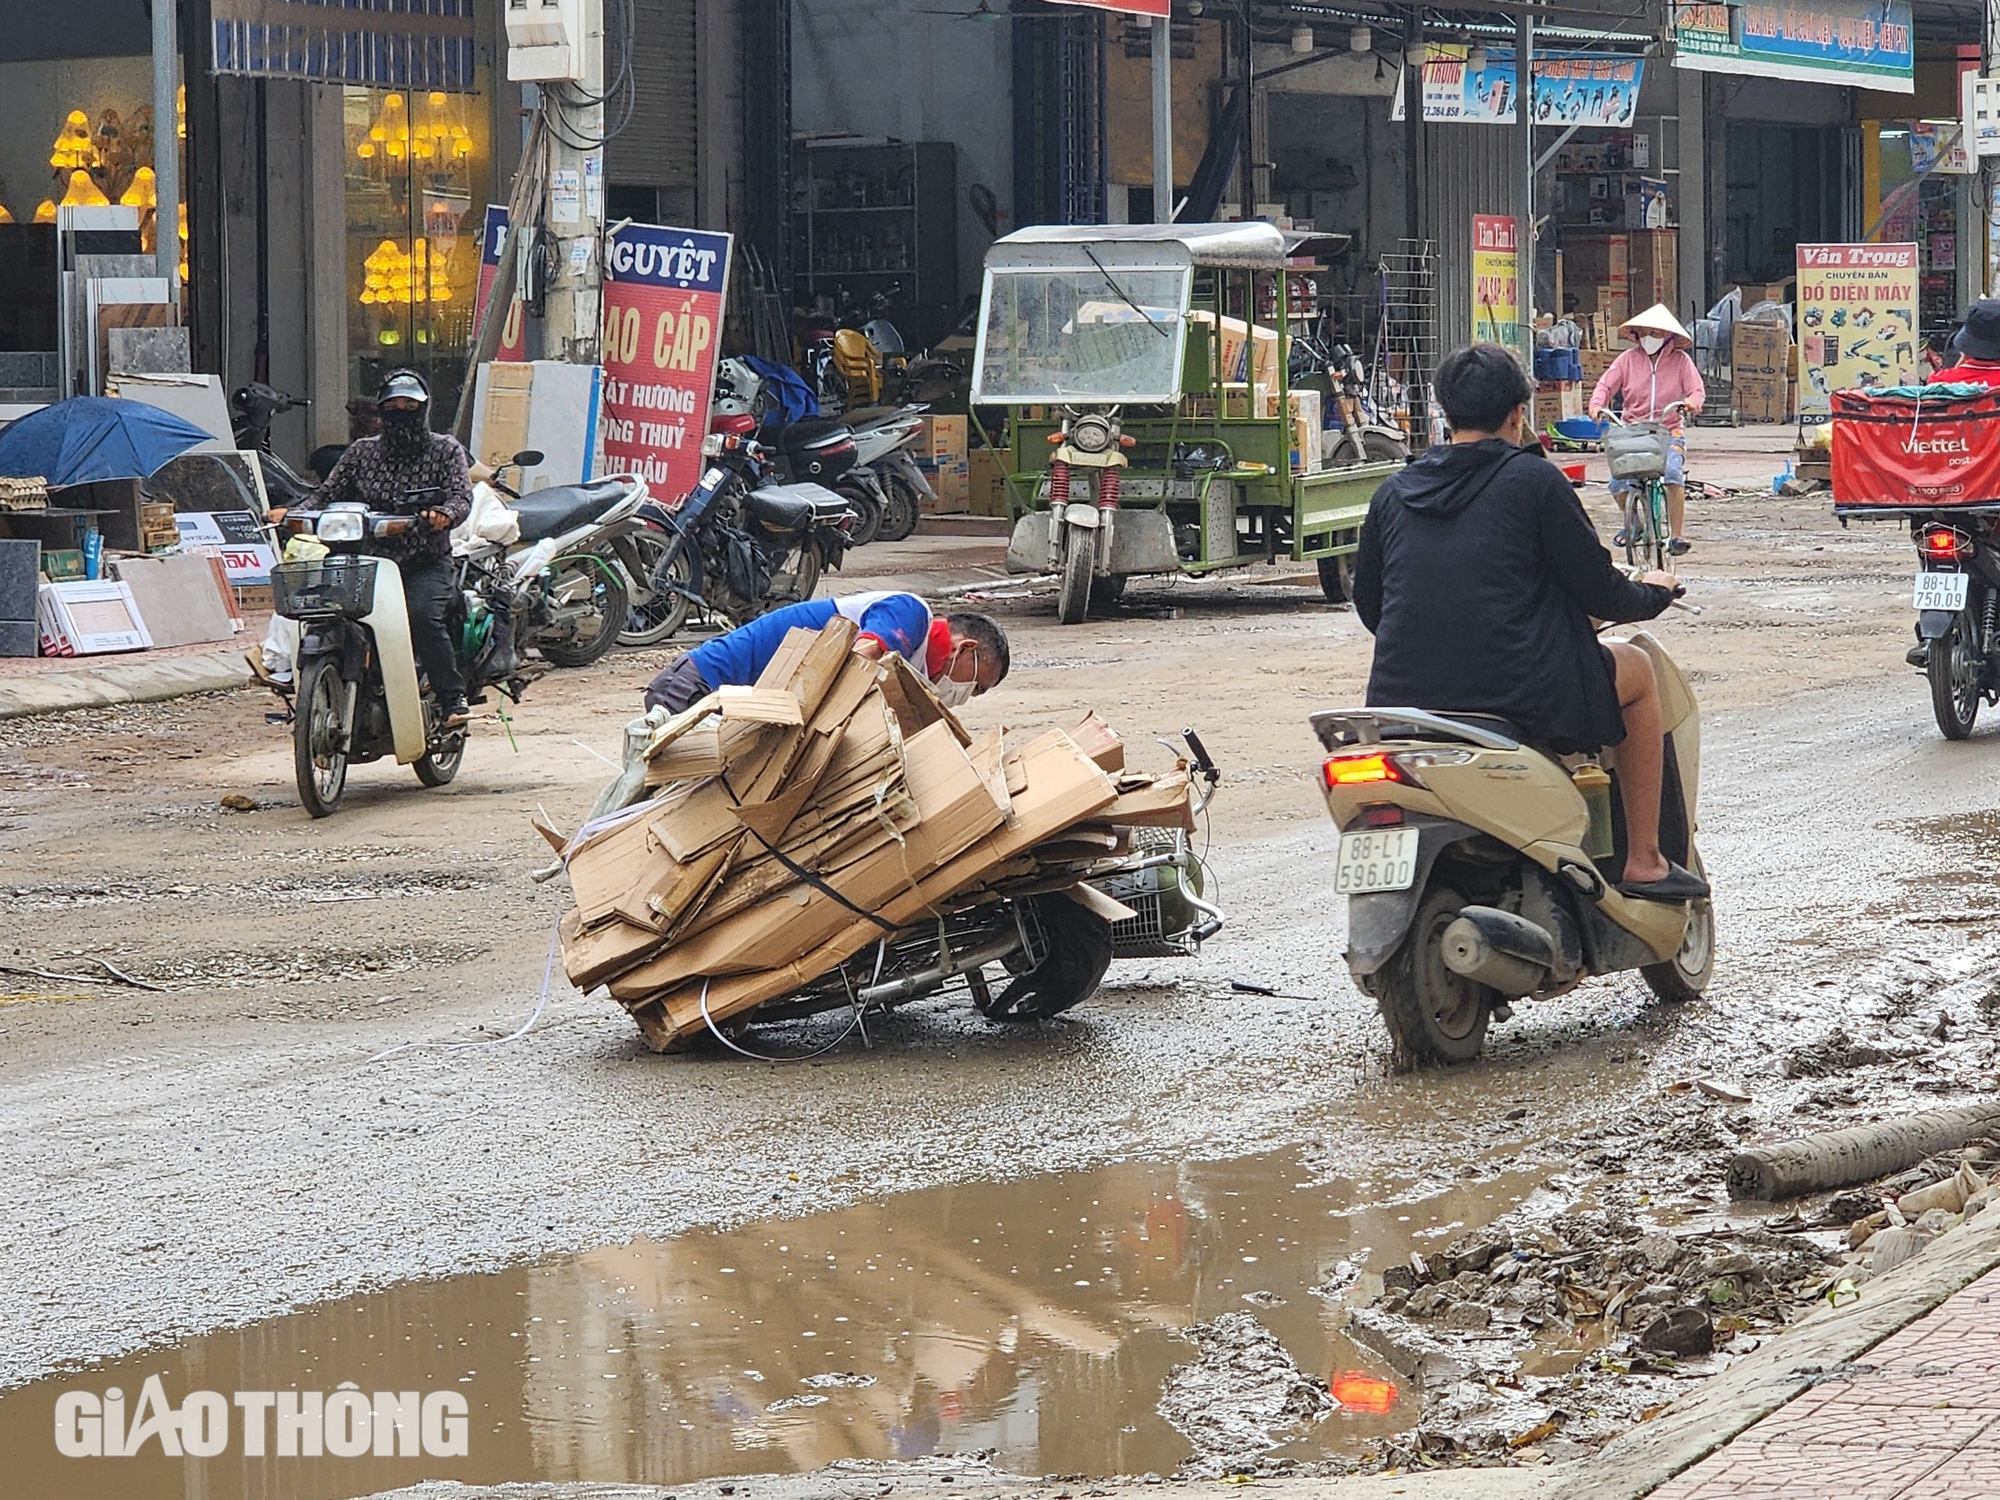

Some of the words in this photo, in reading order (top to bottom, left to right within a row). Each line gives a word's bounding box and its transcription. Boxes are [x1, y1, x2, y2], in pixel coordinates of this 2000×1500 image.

[613, 238, 716, 288] GUYỆT
[1803, 247, 1843, 265] Vân
[1848, 247, 1911, 268] Trọng
[1825, 270, 1866, 280] CHUYÊN
[1868, 271, 1889, 279] BÁN
[1803, 280, 1825, 302] ĐỒ
[1829, 282, 1869, 305] ĐIỆN
[1874, 282, 1912, 302] MÁY
[602, 305, 641, 365] AO
[653, 293, 711, 372] CẤP
[606, 376, 630, 405] ÁT
[632, 383, 696, 415] HƯƠNG
[640, 417, 686, 450] THUỶ
[1901, 437, 1970, 454] viettel
[1949, 456, 1971, 466] post
[1923, 575, 1958, 591] 88-L1
[1916, 592, 1962, 607] 750.09
[1351, 833, 1404, 860] 88-L1
[1340, 861, 1408, 889] 596.00
